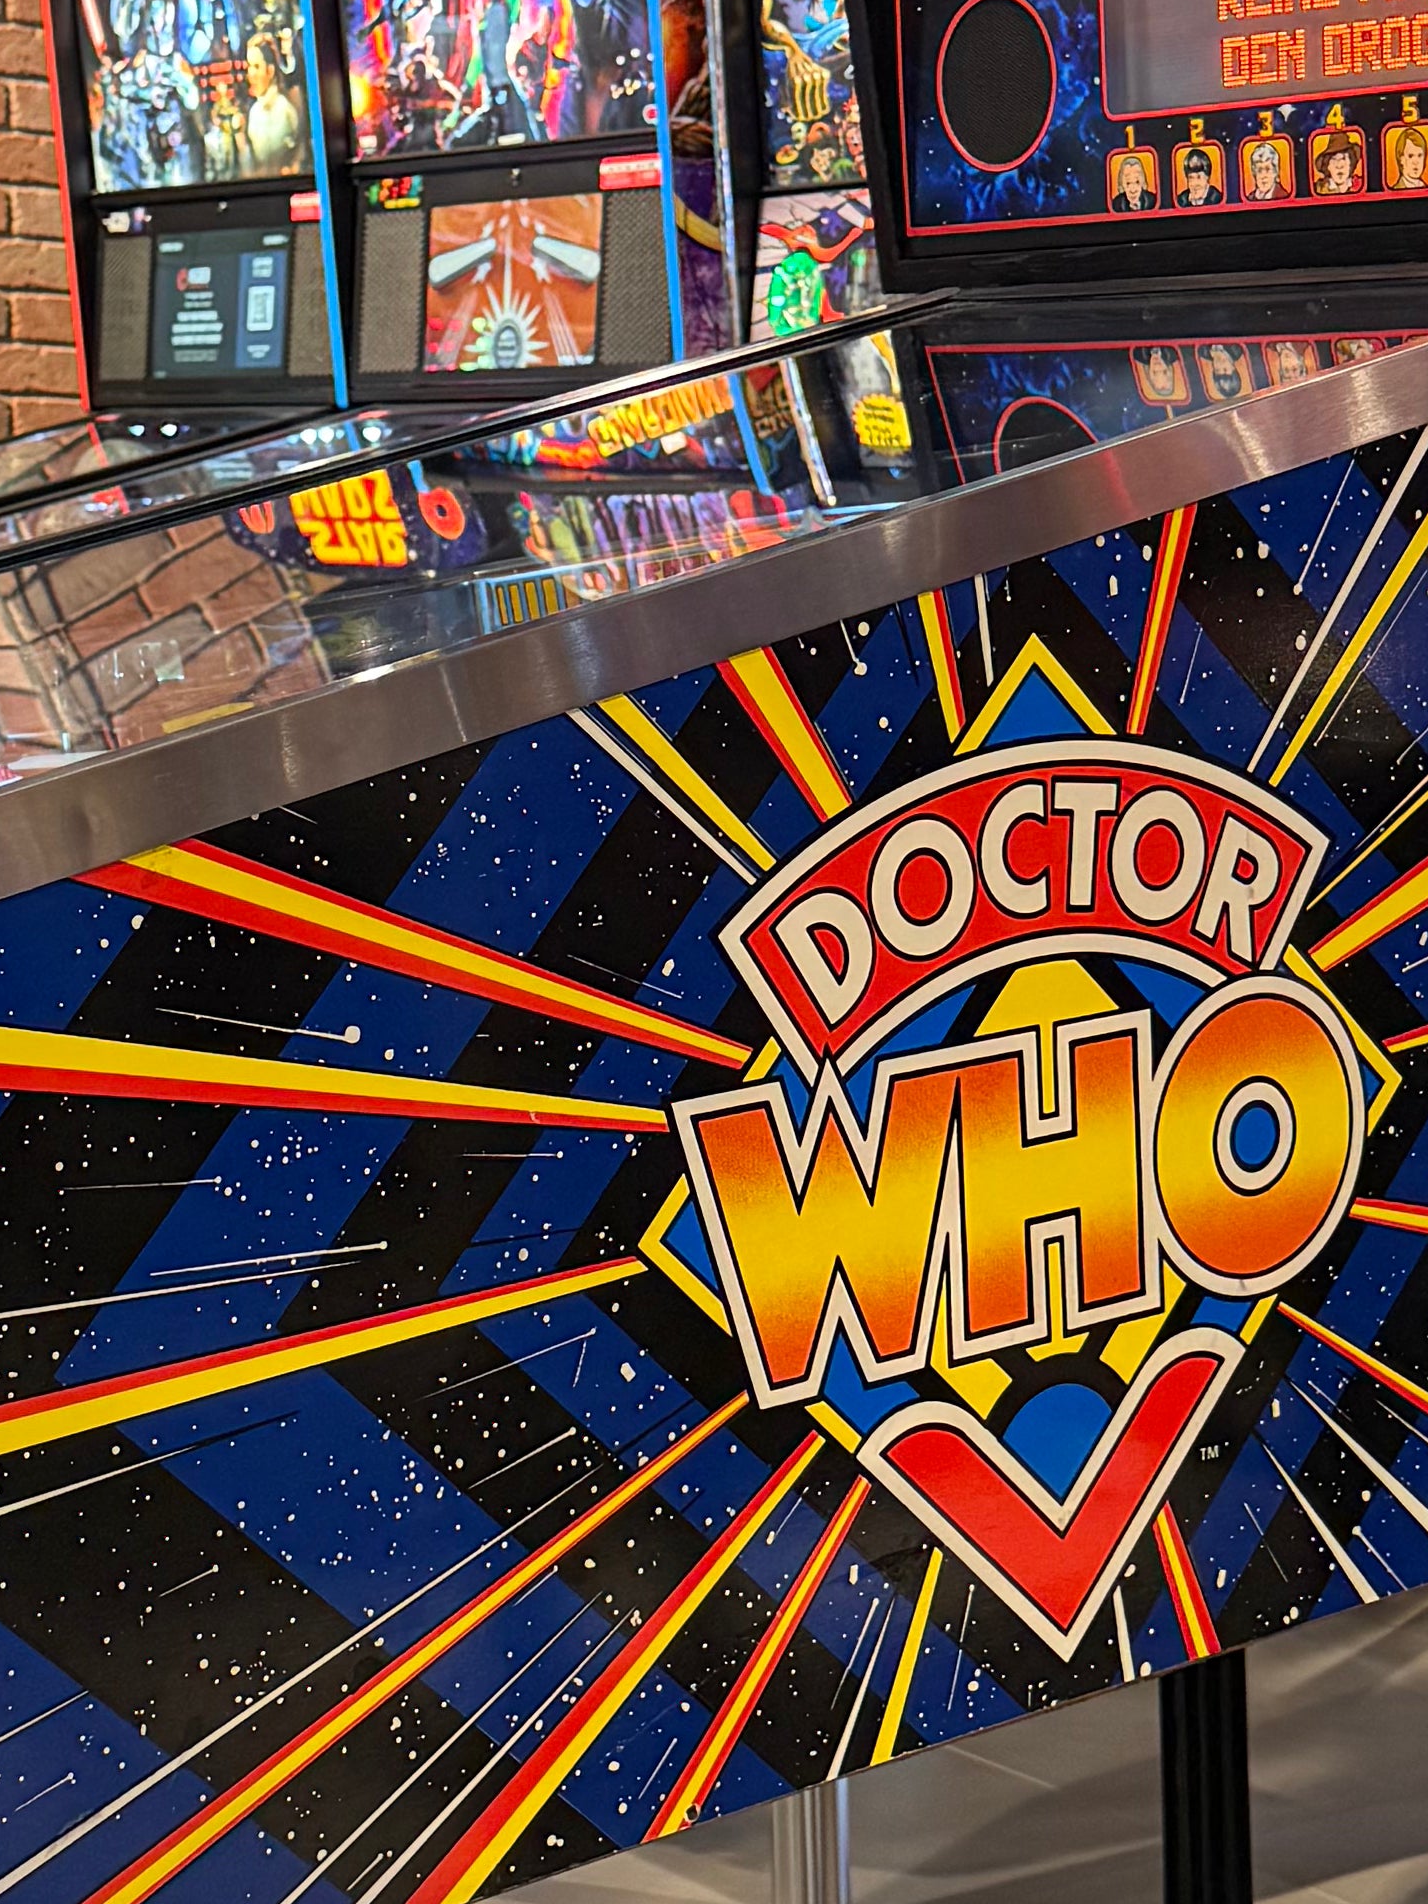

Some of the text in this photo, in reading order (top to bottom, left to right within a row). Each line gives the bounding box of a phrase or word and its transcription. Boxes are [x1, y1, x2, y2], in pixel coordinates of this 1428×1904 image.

[1222, 29, 1306, 87] DEN
[1124, 124, 1137, 150] 1
[1188, 118, 1207, 145] 2
[1258, 111, 1275, 138] 3
[1325, 103, 1346, 131] 4
[1401, 94, 1420, 125] 5
[776, 778, 1287, 1027] DOCTOR
[673, 976, 1367, 1408] WHO
[1199, 1445, 1219, 1461] TM
